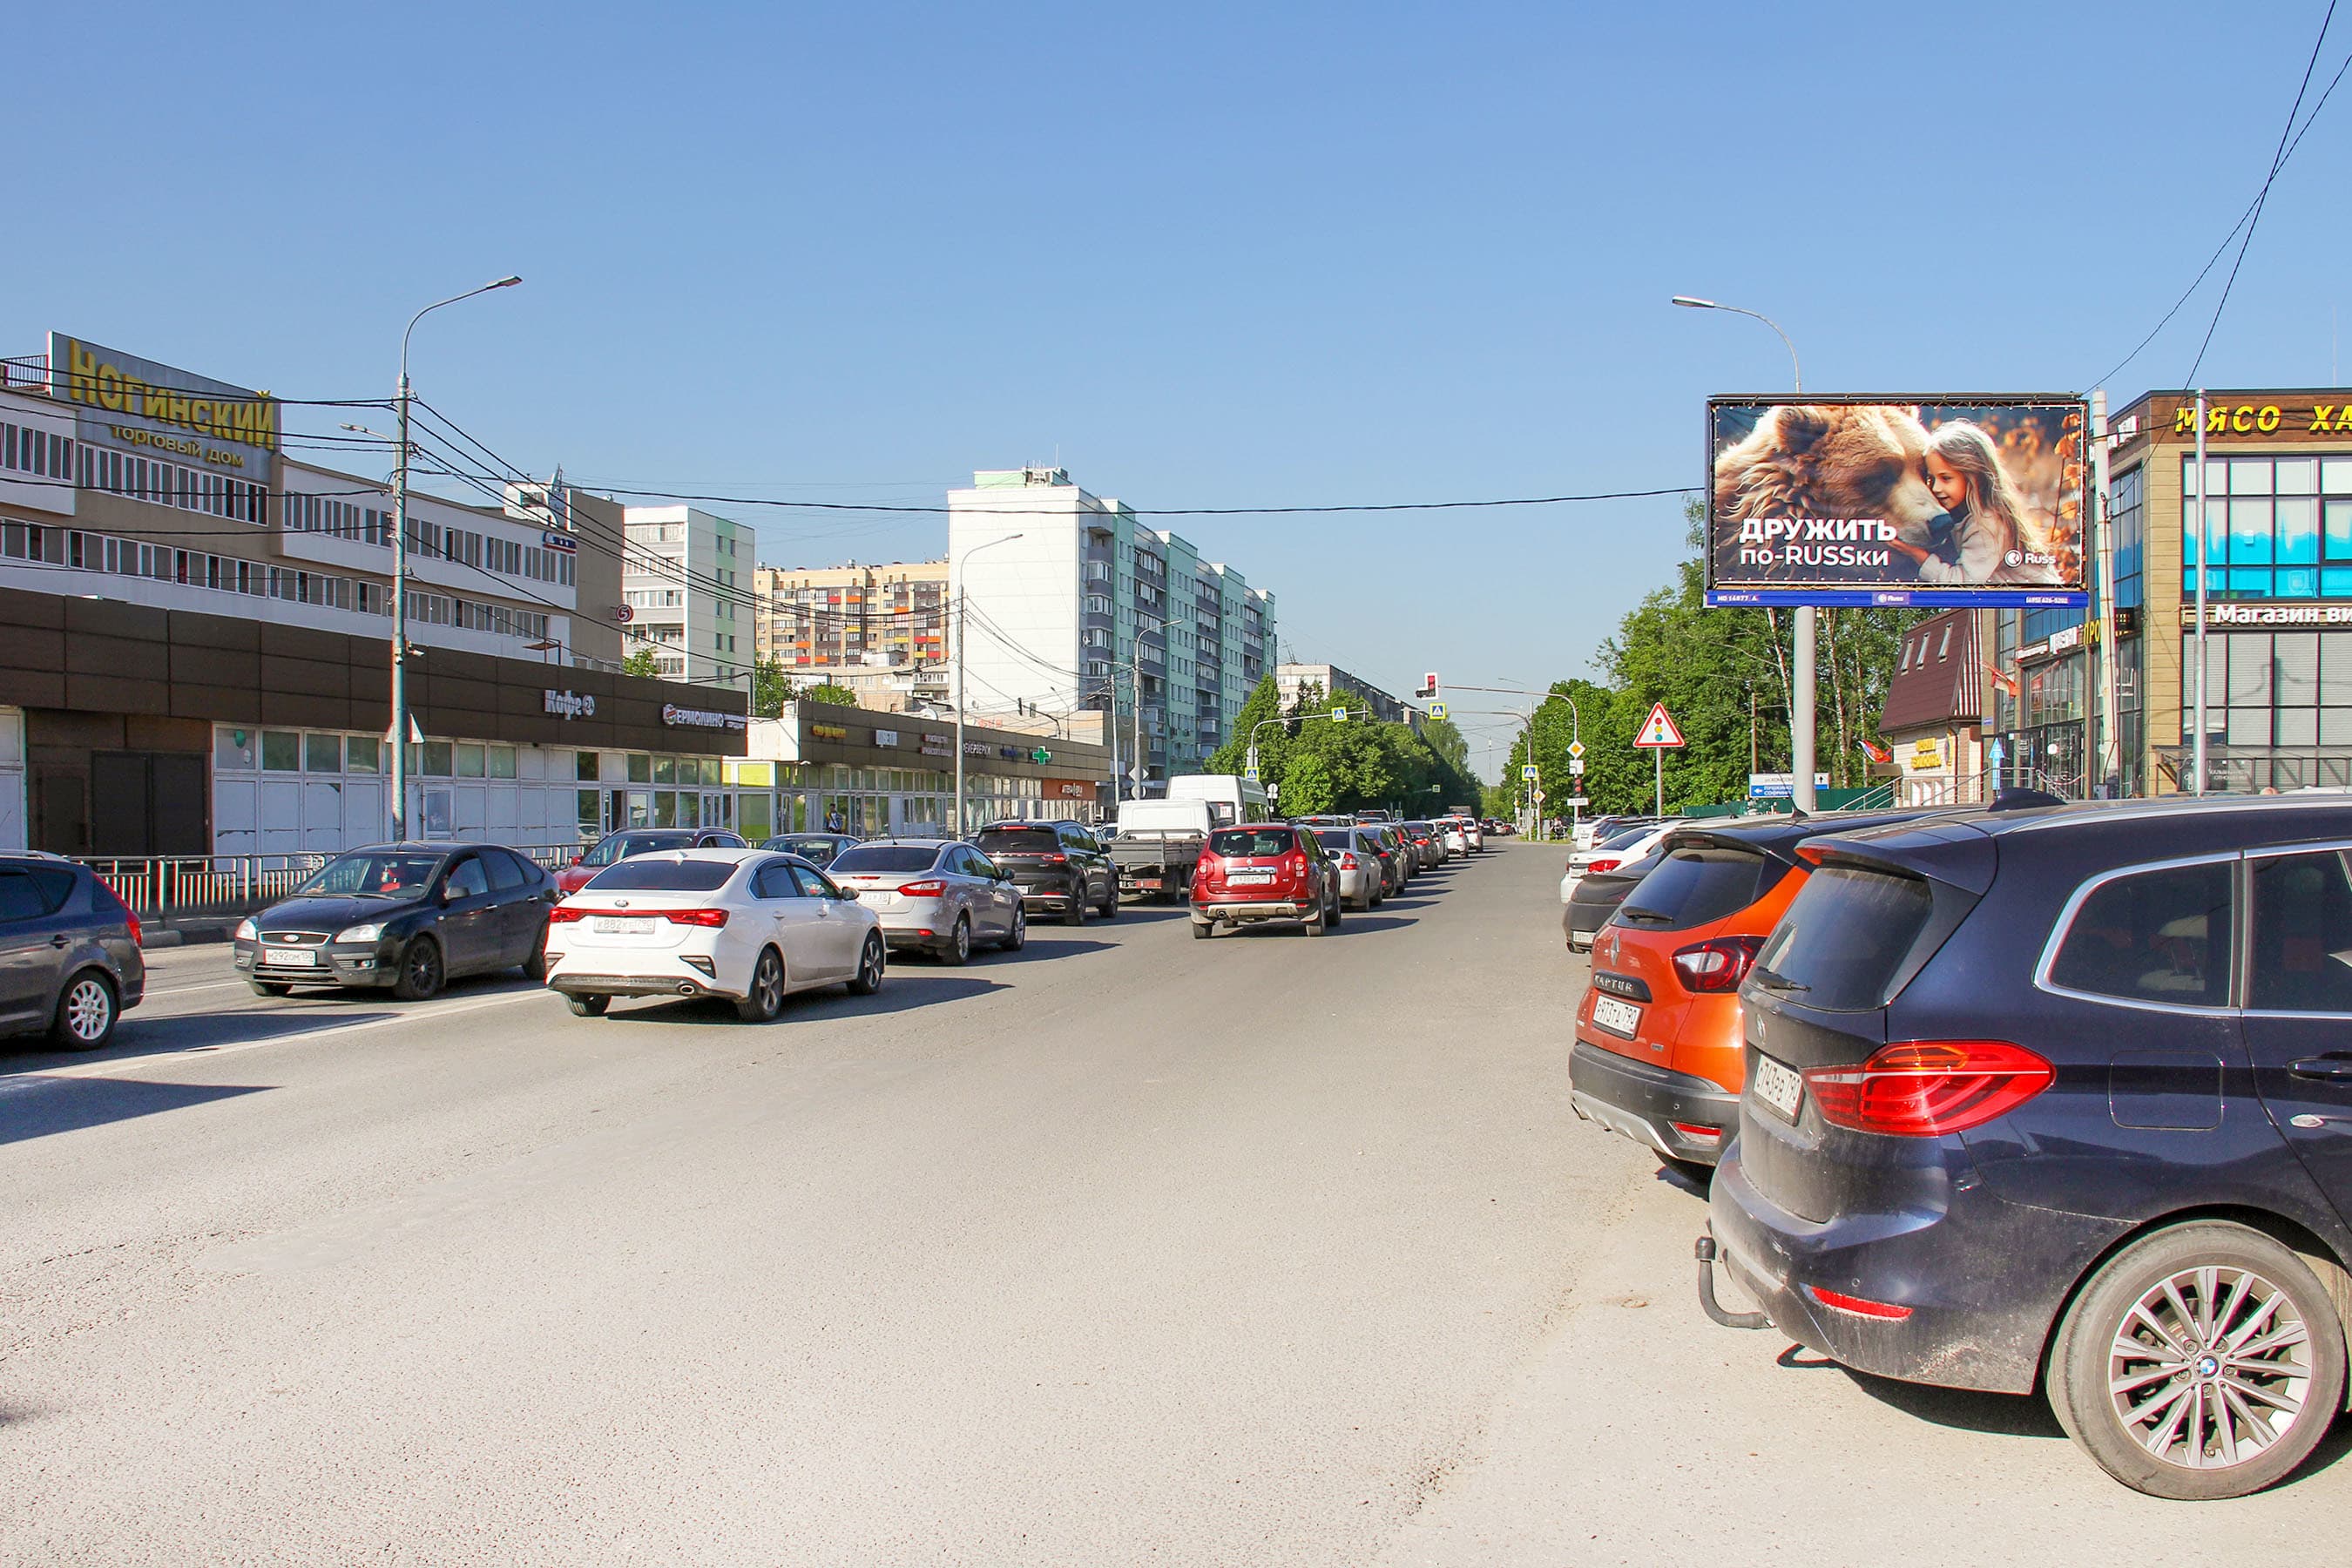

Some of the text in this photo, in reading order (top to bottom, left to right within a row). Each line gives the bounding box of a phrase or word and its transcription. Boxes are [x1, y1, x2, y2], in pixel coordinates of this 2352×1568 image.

[70, 338, 274, 450] НОГИНСКИЙ
[2175, 405, 2282, 433] МЯСО
[1739, 518, 1897, 544] ДРУЖИТЬ
[1740, 545, 1889, 566] по-RUSSки
[2024, 552, 2057, 564] Russ
[2214, 604, 2319, 624] Магазин
[544, 689, 582, 720] Кафе
[676, 709, 725, 727] ЕРМОЛИНО
